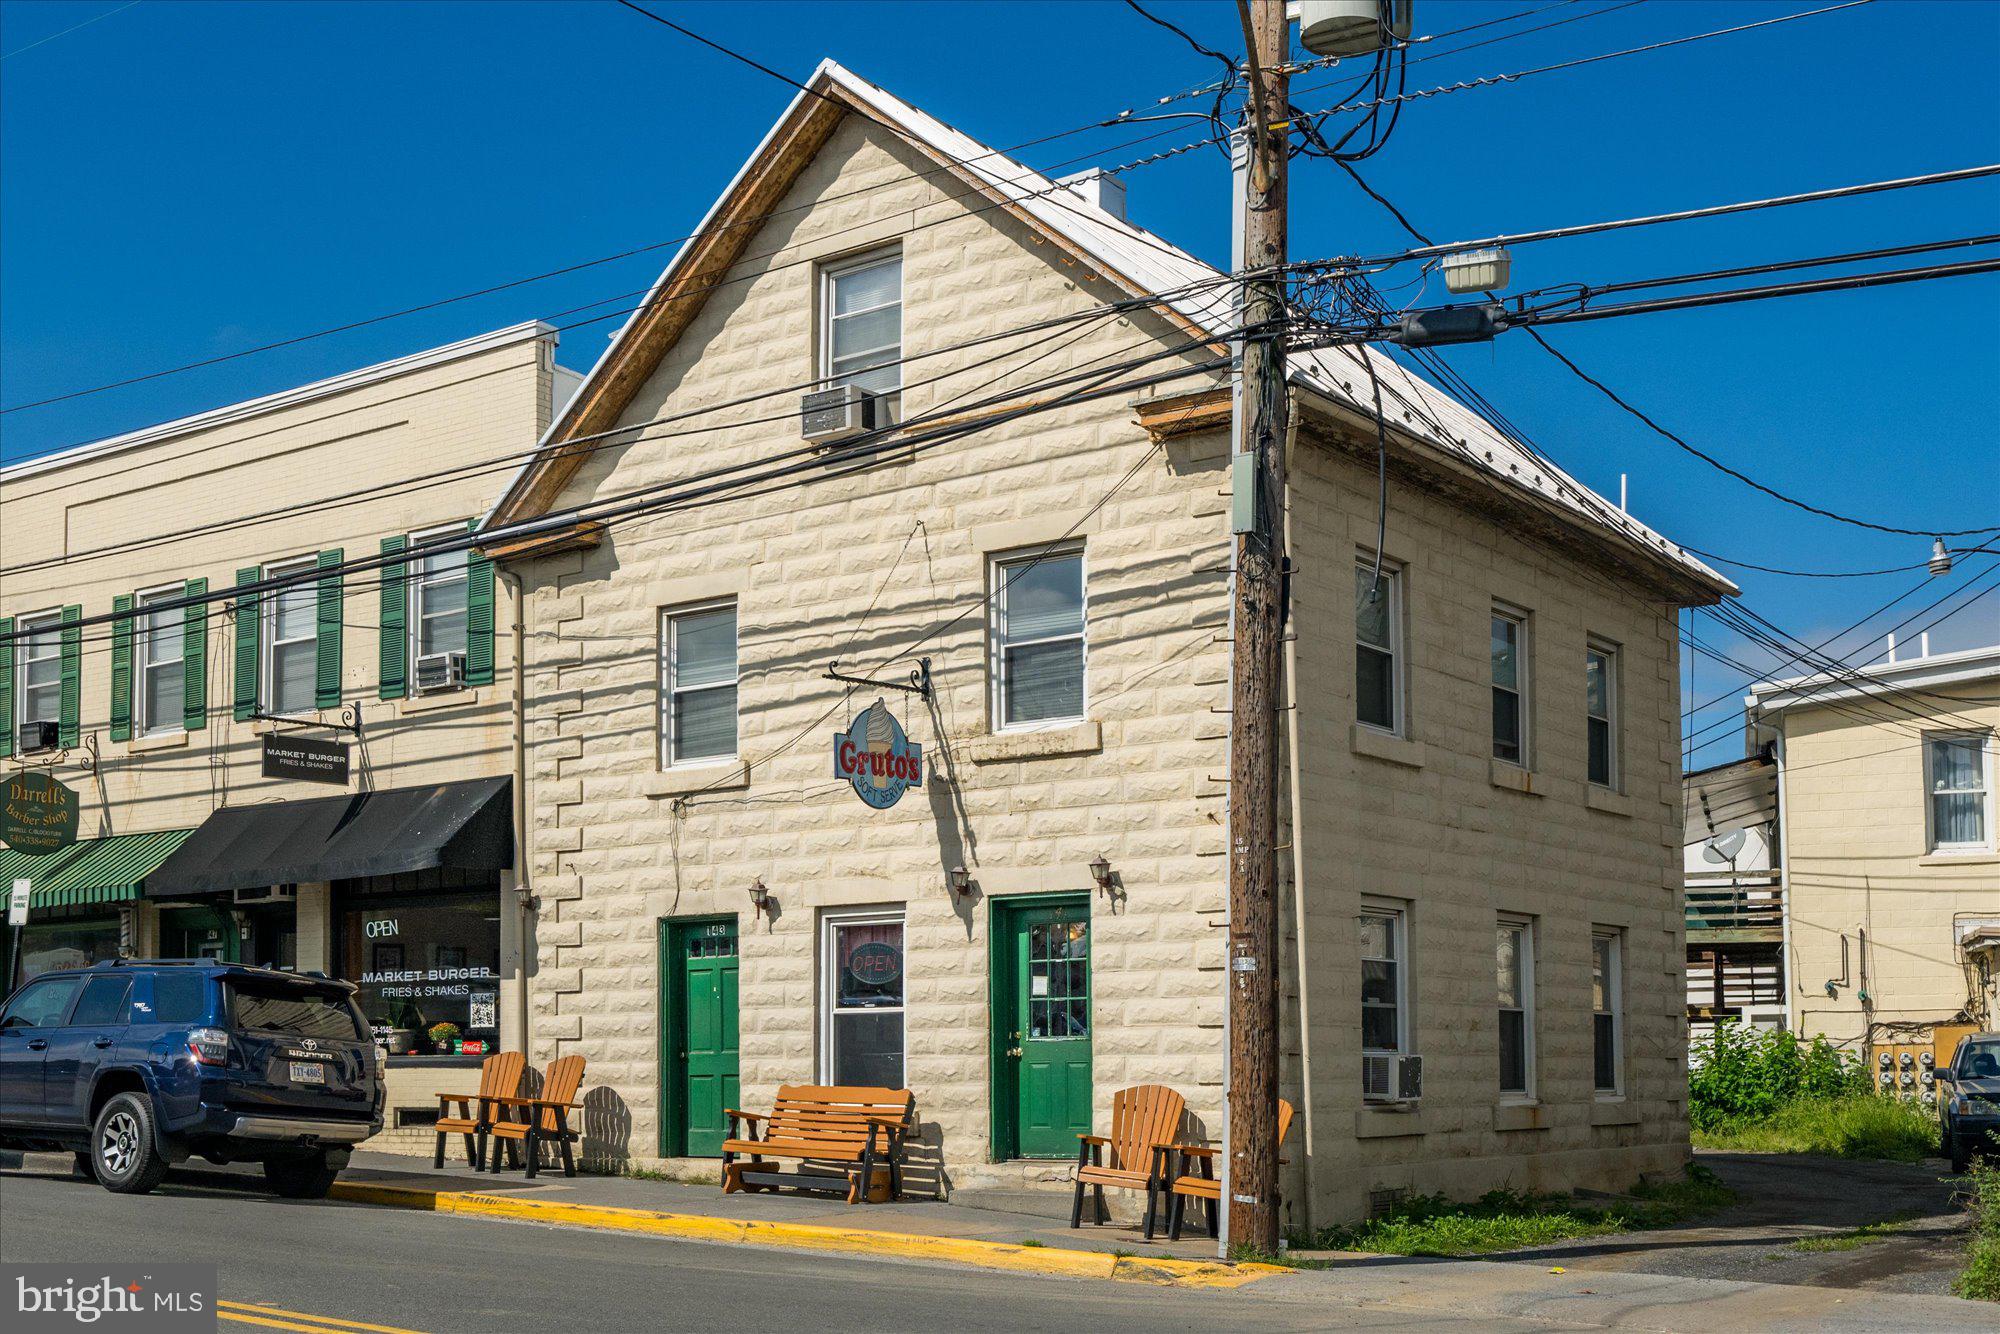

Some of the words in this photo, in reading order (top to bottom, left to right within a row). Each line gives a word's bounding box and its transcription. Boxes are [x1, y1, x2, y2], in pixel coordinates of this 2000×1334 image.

[266, 748, 305, 759] MARKET
[308, 753, 346, 763] BURGER
[279, 758, 299, 767] FRIES
[306, 761, 334, 770] SHAKES
[840, 740, 919, 781] Gruto's
[10, 784, 66, 806] Darrell's
[857, 776, 878, 802] SOFT
[880, 780, 904, 804] SERVE
[5, 803, 40, 826] Barber
[42, 809, 68, 826] Shop
[366, 918, 399, 938] OPEN
[852, 955, 898, 973] OPEN
[362, 971, 422, 983] MARKET
[428, 967, 490, 981] BURGER
[382, 986, 412, 998] FRIES
[414, 987, 422, 996] &
[425, 984, 469, 996] SHAKES
